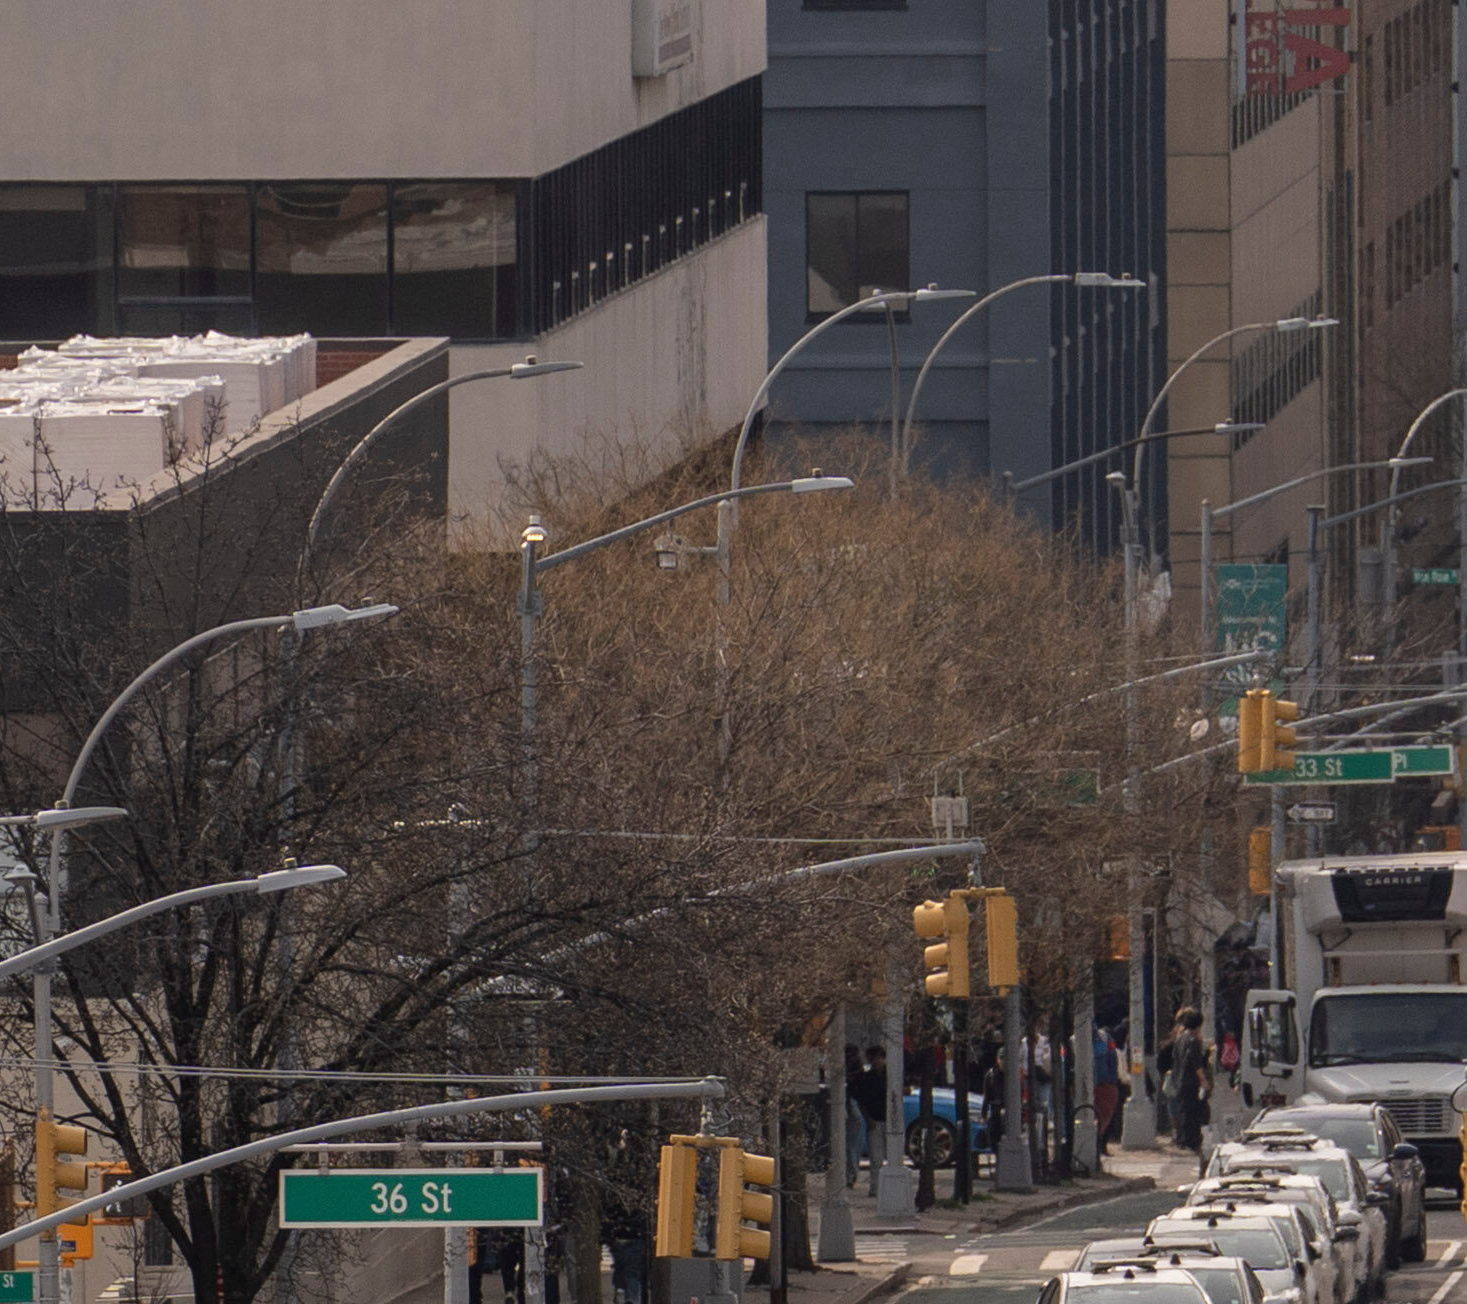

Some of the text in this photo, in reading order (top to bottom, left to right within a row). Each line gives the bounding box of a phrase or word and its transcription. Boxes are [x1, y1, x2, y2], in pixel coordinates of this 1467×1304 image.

[1325, 757, 1342, 776] St
[1365, 875, 1422, 887] CARRIER
[371, 1183, 454, 1215] 36 St
[2, 1274, 16, 1289] St
